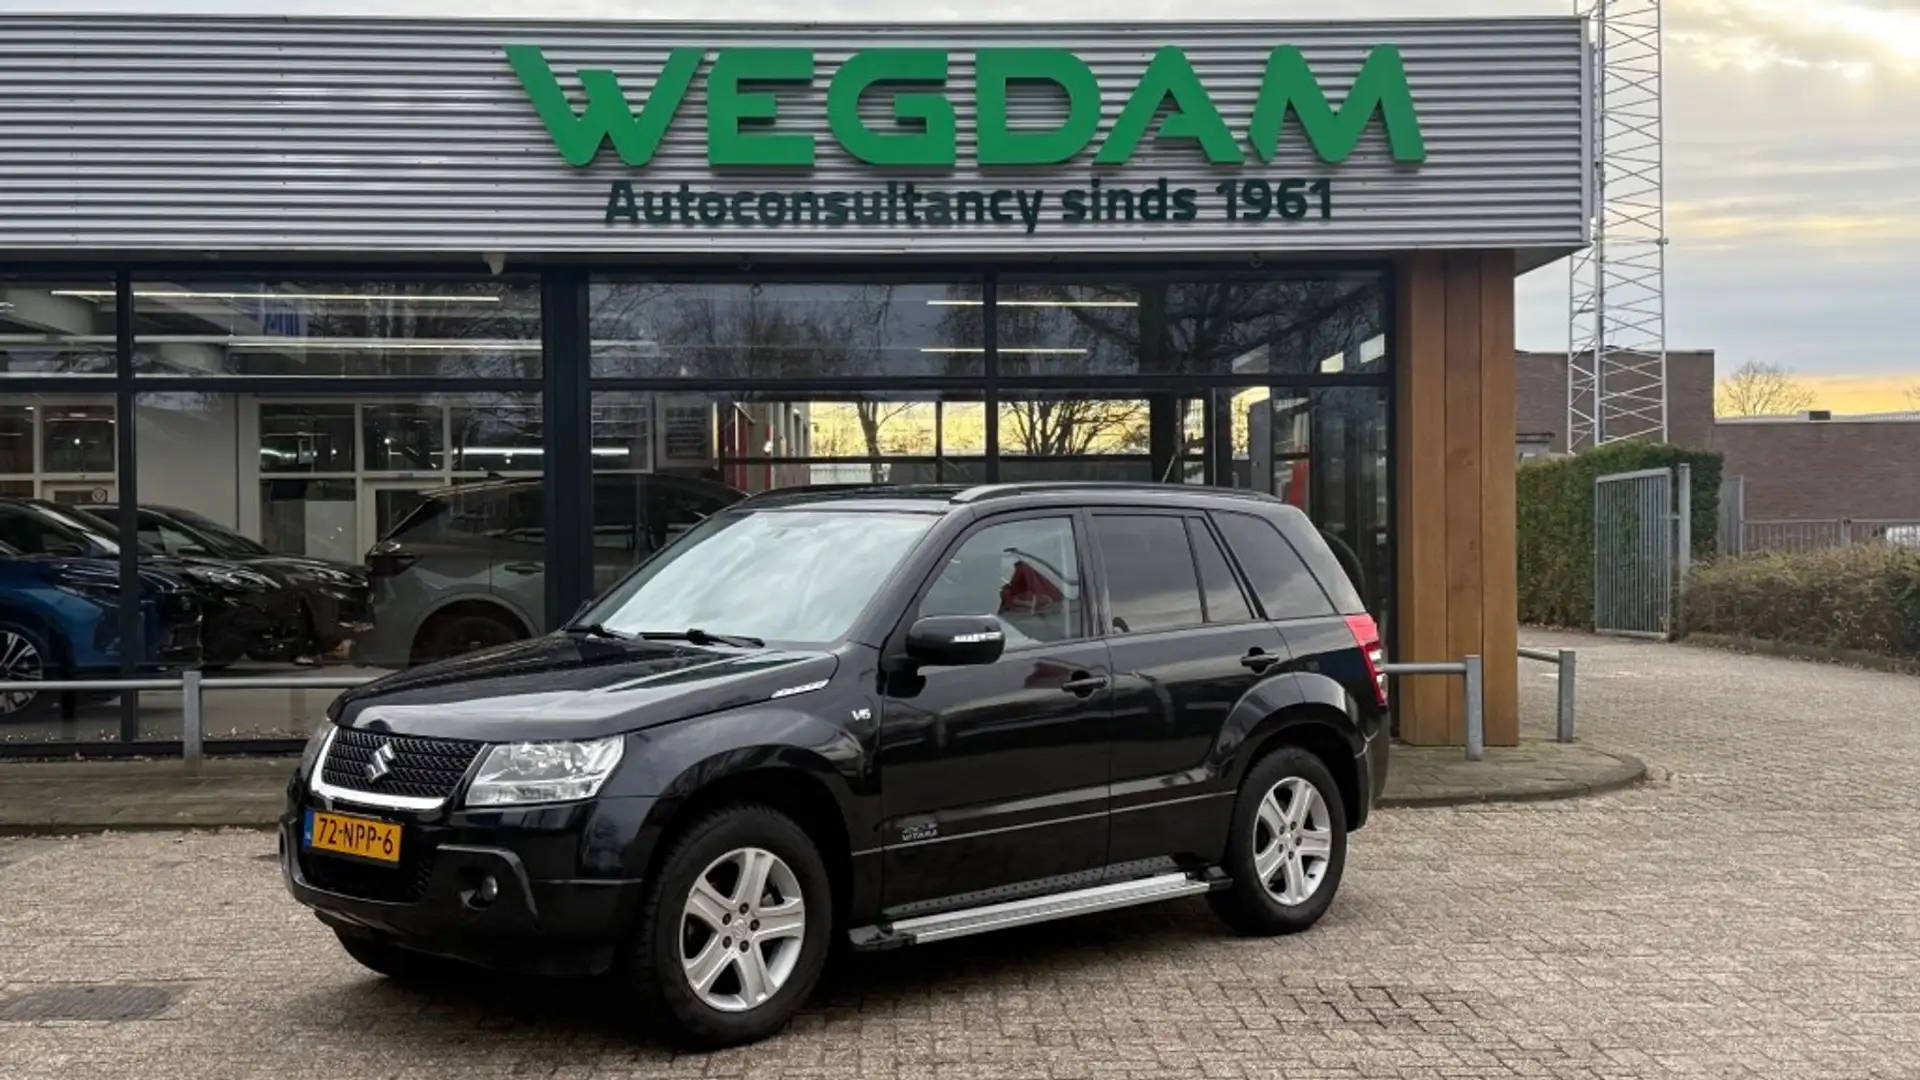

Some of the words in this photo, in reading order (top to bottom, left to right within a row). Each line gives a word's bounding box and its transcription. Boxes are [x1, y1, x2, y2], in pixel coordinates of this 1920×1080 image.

[503, 44, 1427, 167] WEGDAM
[605, 179, 1043, 234] Autoconsultancy
[1061, 177, 1198, 223] sinds
[1215, 177, 1332, 222] 1961
[851, 708, 872, 721] V6
[318, 817, 394, 856] 72-NPP-6
